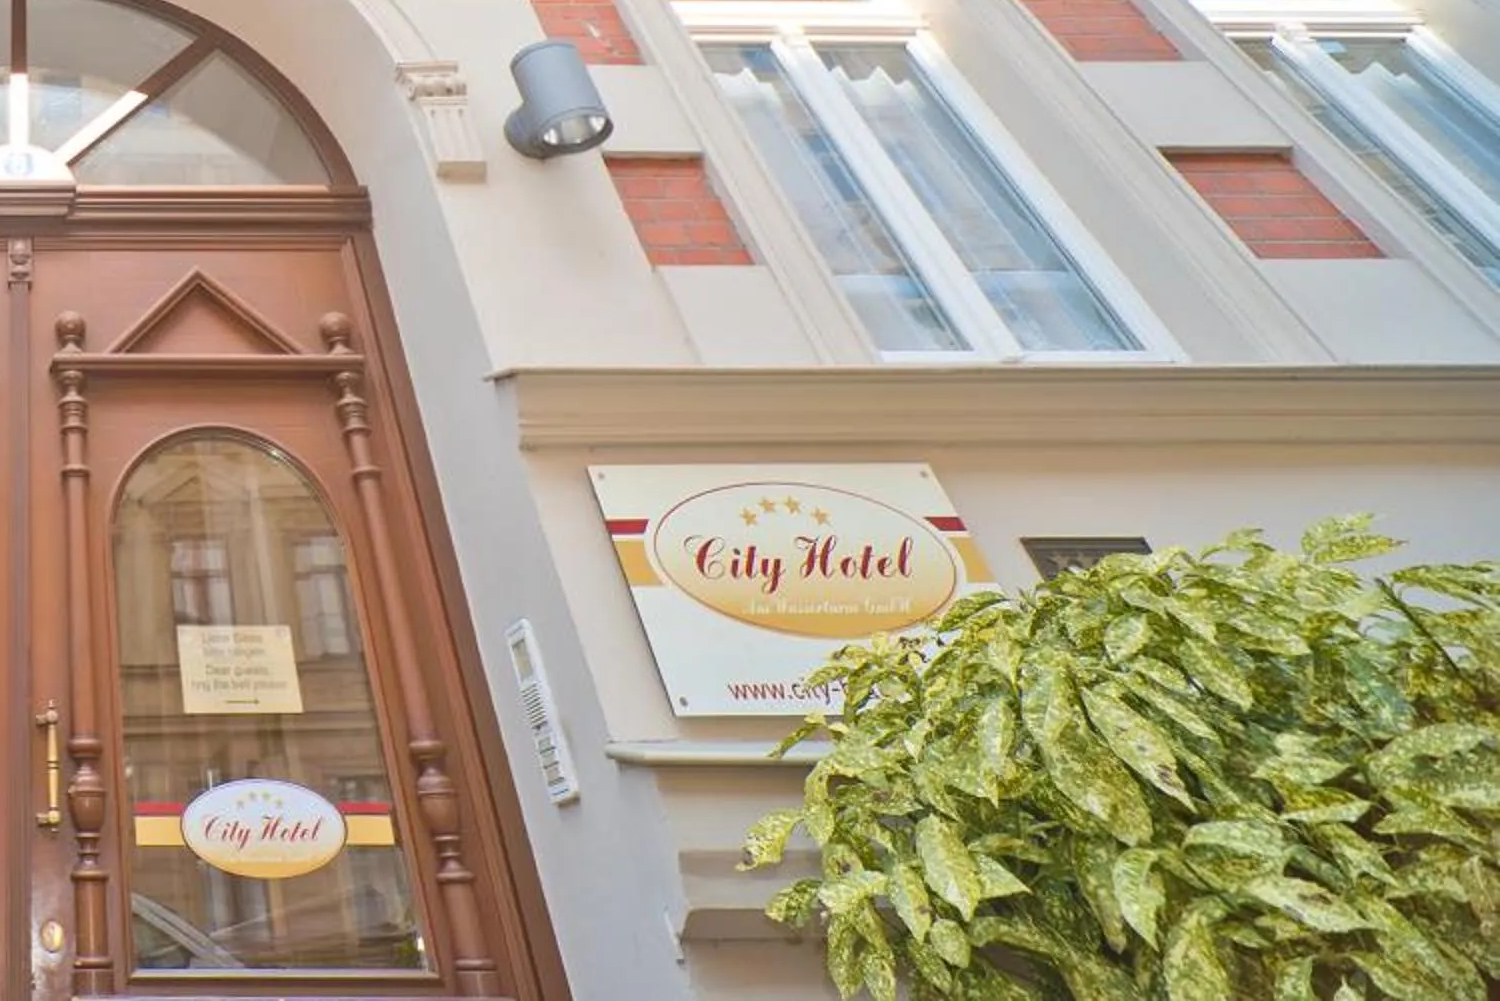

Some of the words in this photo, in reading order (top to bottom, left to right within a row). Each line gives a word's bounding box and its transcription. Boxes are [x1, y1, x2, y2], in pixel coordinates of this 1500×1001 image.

[683, 535, 786, 593] City
[793, 534, 914, 580] Hotel
[201, 815, 251, 849] City
[261, 815, 325, 843] Hotel
